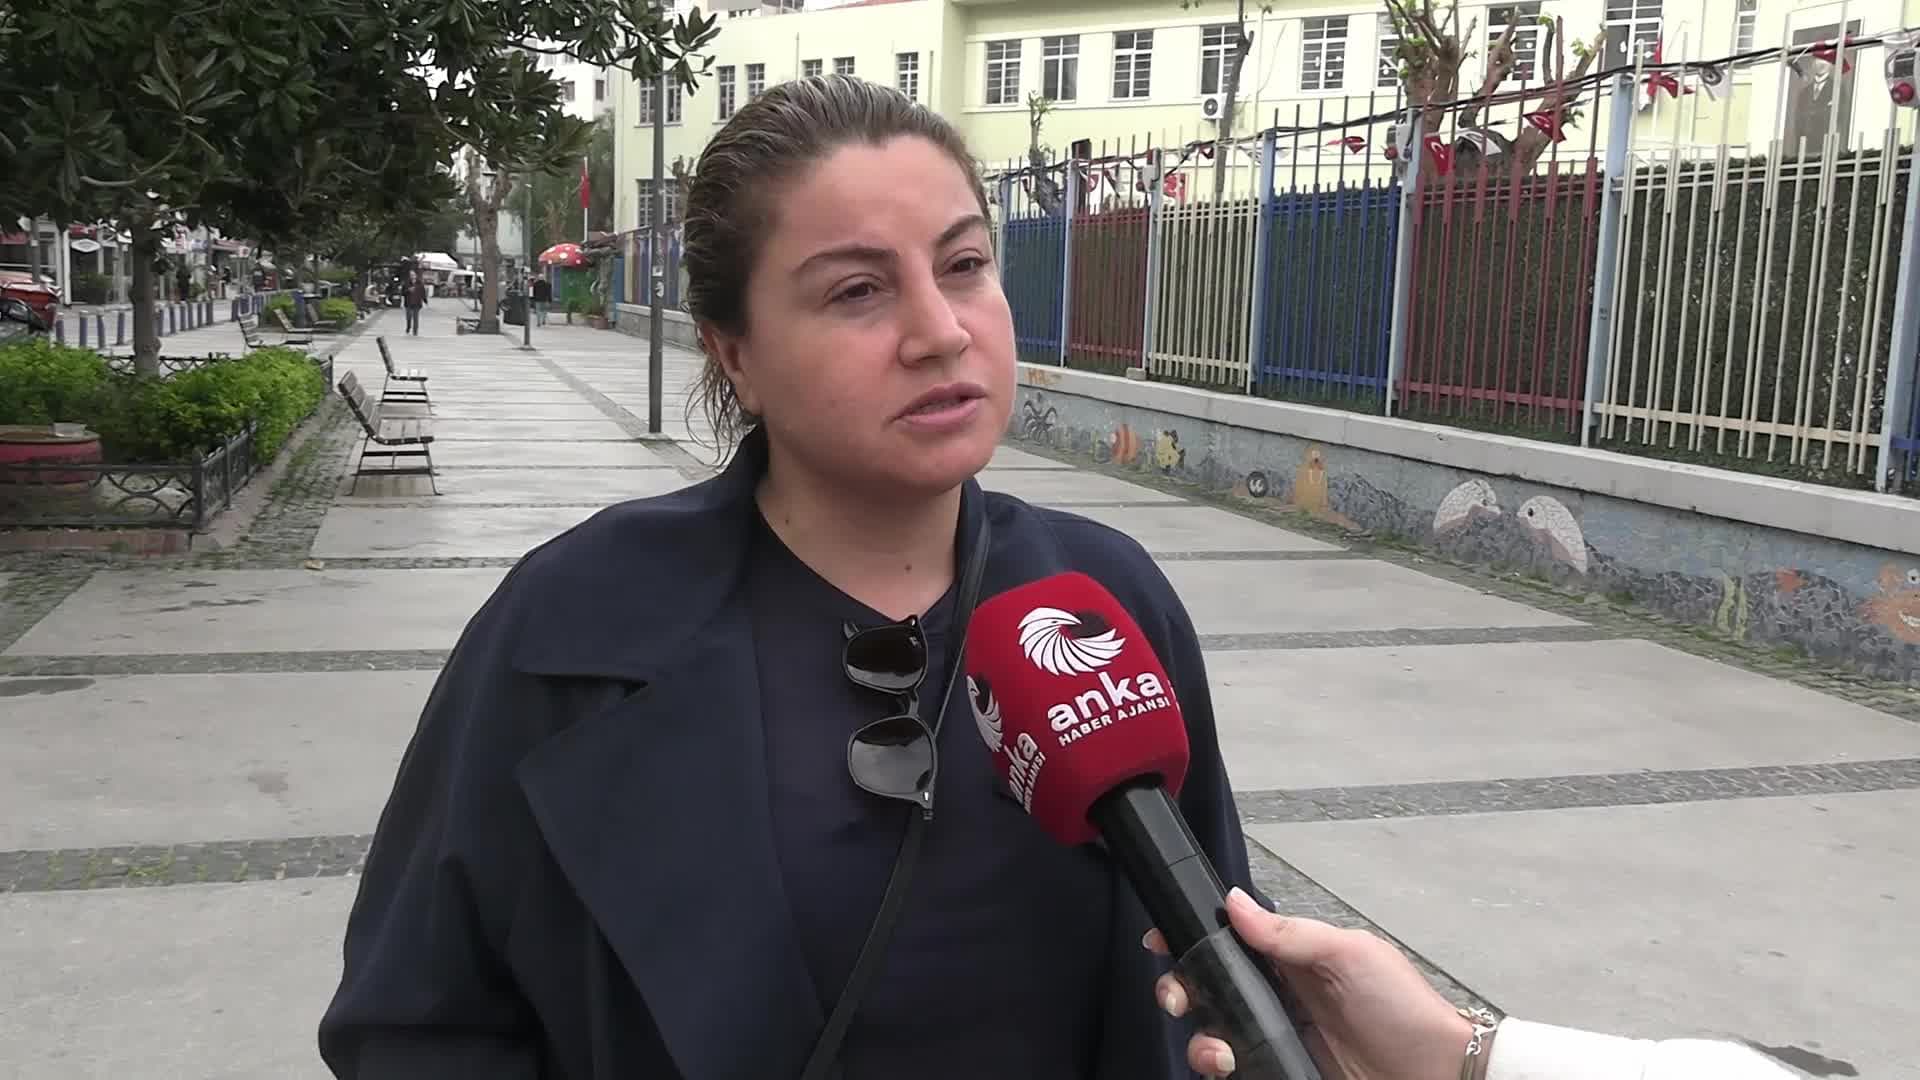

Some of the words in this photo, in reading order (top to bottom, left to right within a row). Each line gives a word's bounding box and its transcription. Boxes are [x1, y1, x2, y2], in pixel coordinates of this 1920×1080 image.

[1048, 671, 1164, 731] anka
[1058, 714, 1113, 746] HABER
[1117, 696, 1171, 720] AJANSI
